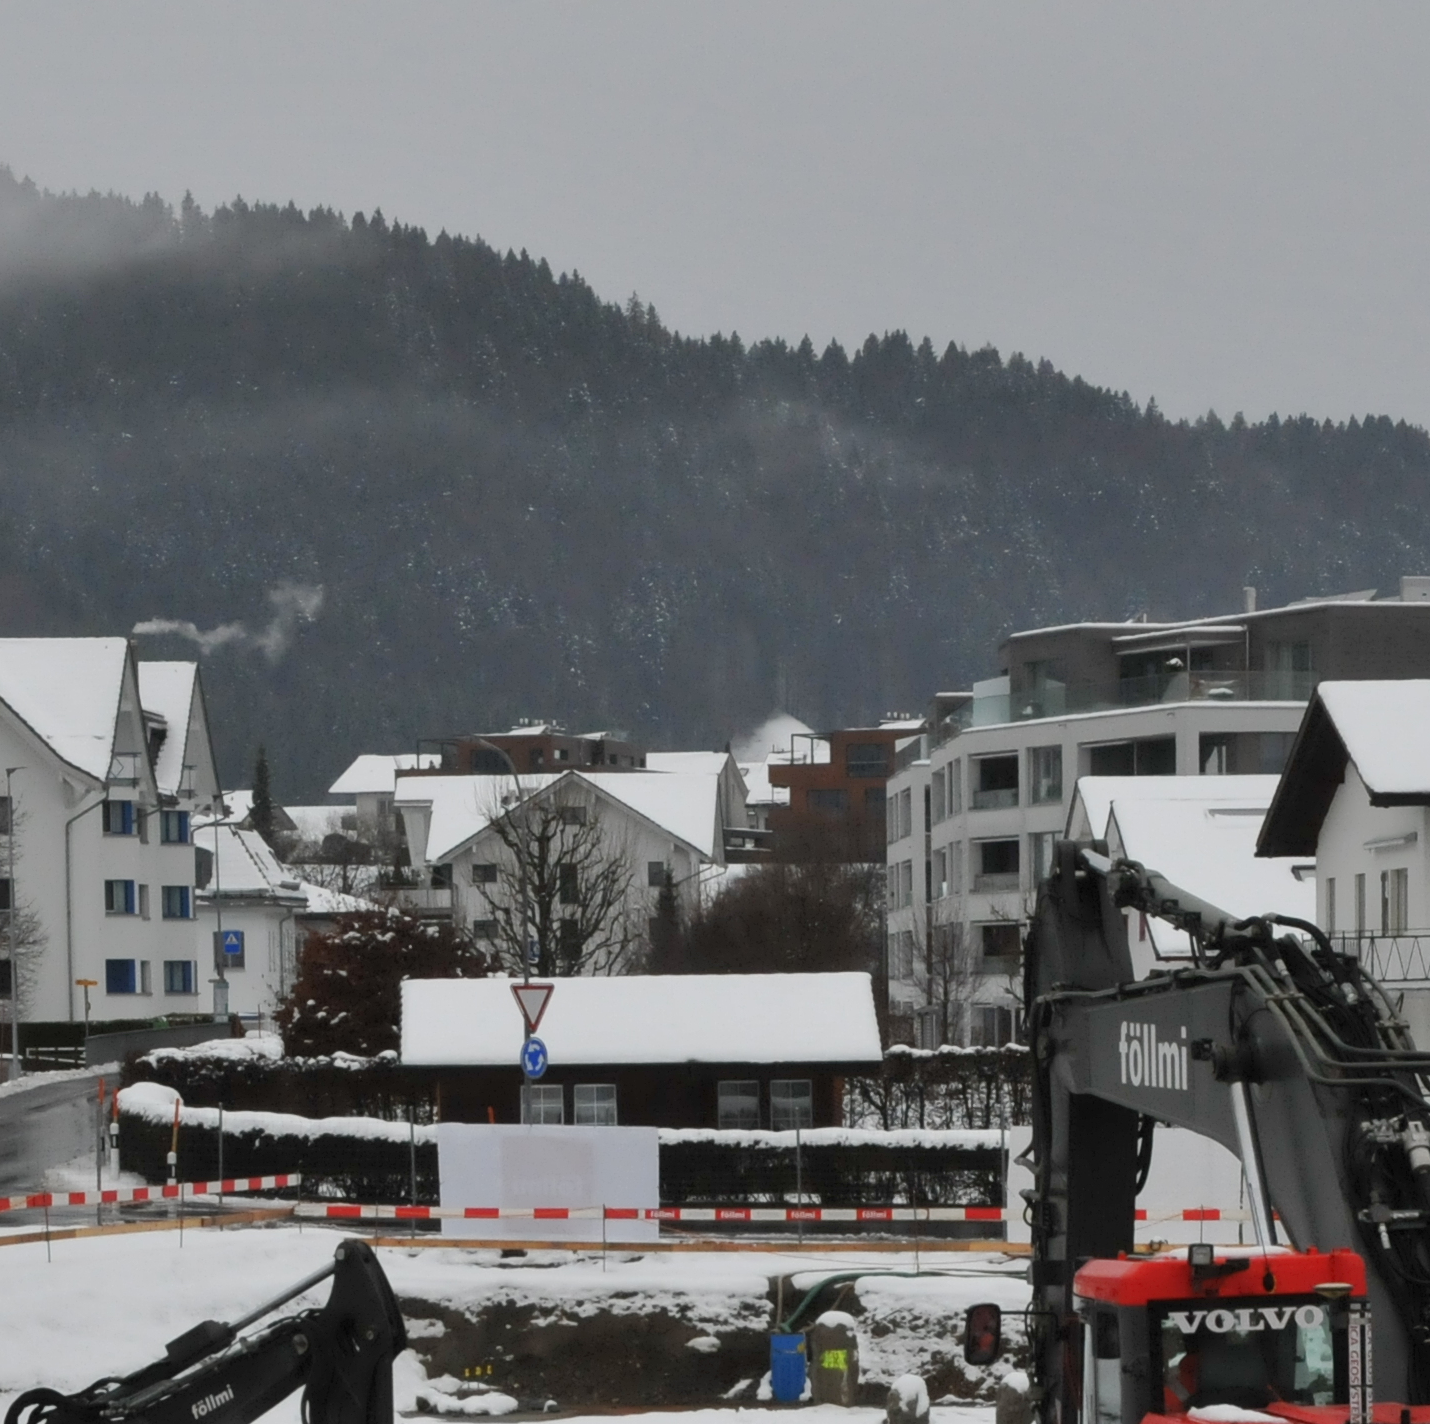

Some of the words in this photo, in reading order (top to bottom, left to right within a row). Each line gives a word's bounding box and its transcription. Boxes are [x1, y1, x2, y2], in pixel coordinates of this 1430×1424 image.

[1119, 1021, 1188, 1090] föllmi
[1168, 1305, 1323, 1334] VOLVO
[192, 1383, 234, 1420] föllmi
